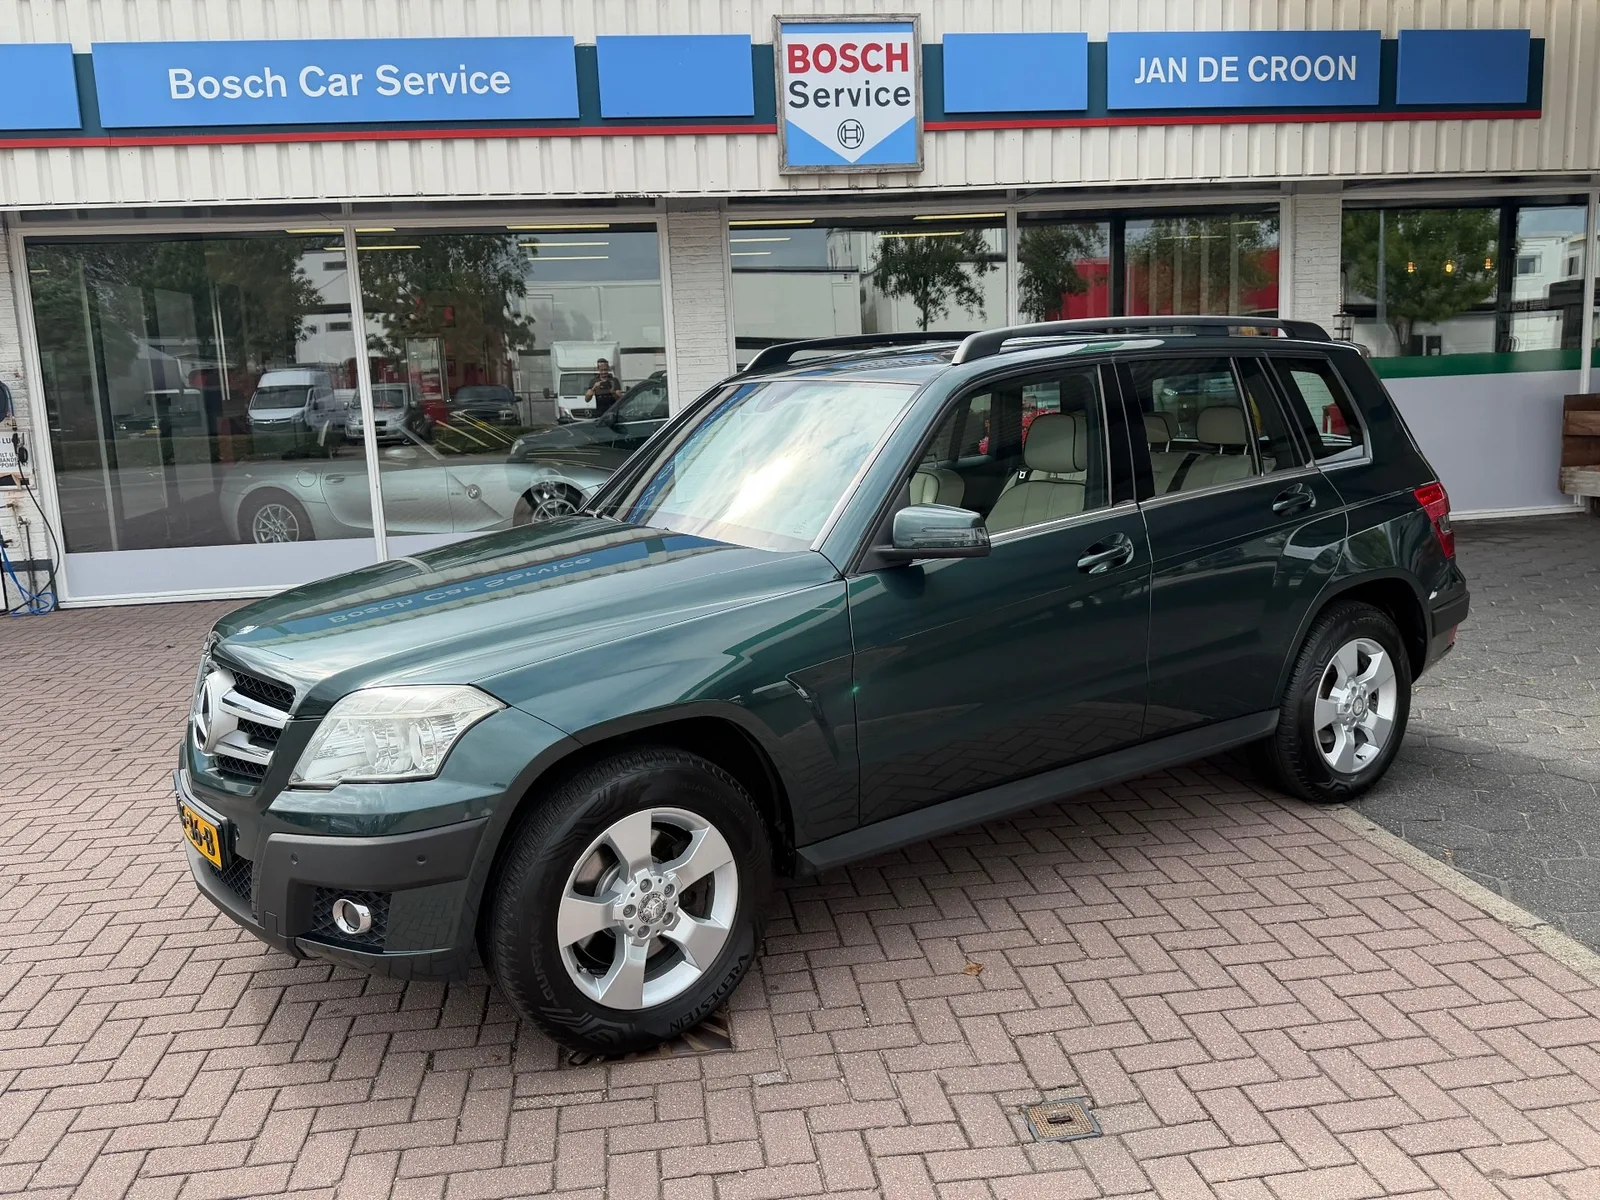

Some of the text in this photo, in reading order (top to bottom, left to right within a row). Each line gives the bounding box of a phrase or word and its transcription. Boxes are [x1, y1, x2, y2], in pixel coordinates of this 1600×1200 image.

[787, 42, 909, 74] BOSCH
[1134, 55, 1357, 84] JAN DE CROON
[168, 63, 511, 99] Bosch Car Service
[788, 80, 911, 109] Service
[669, 952, 749, 1033] VREDESTEIN
